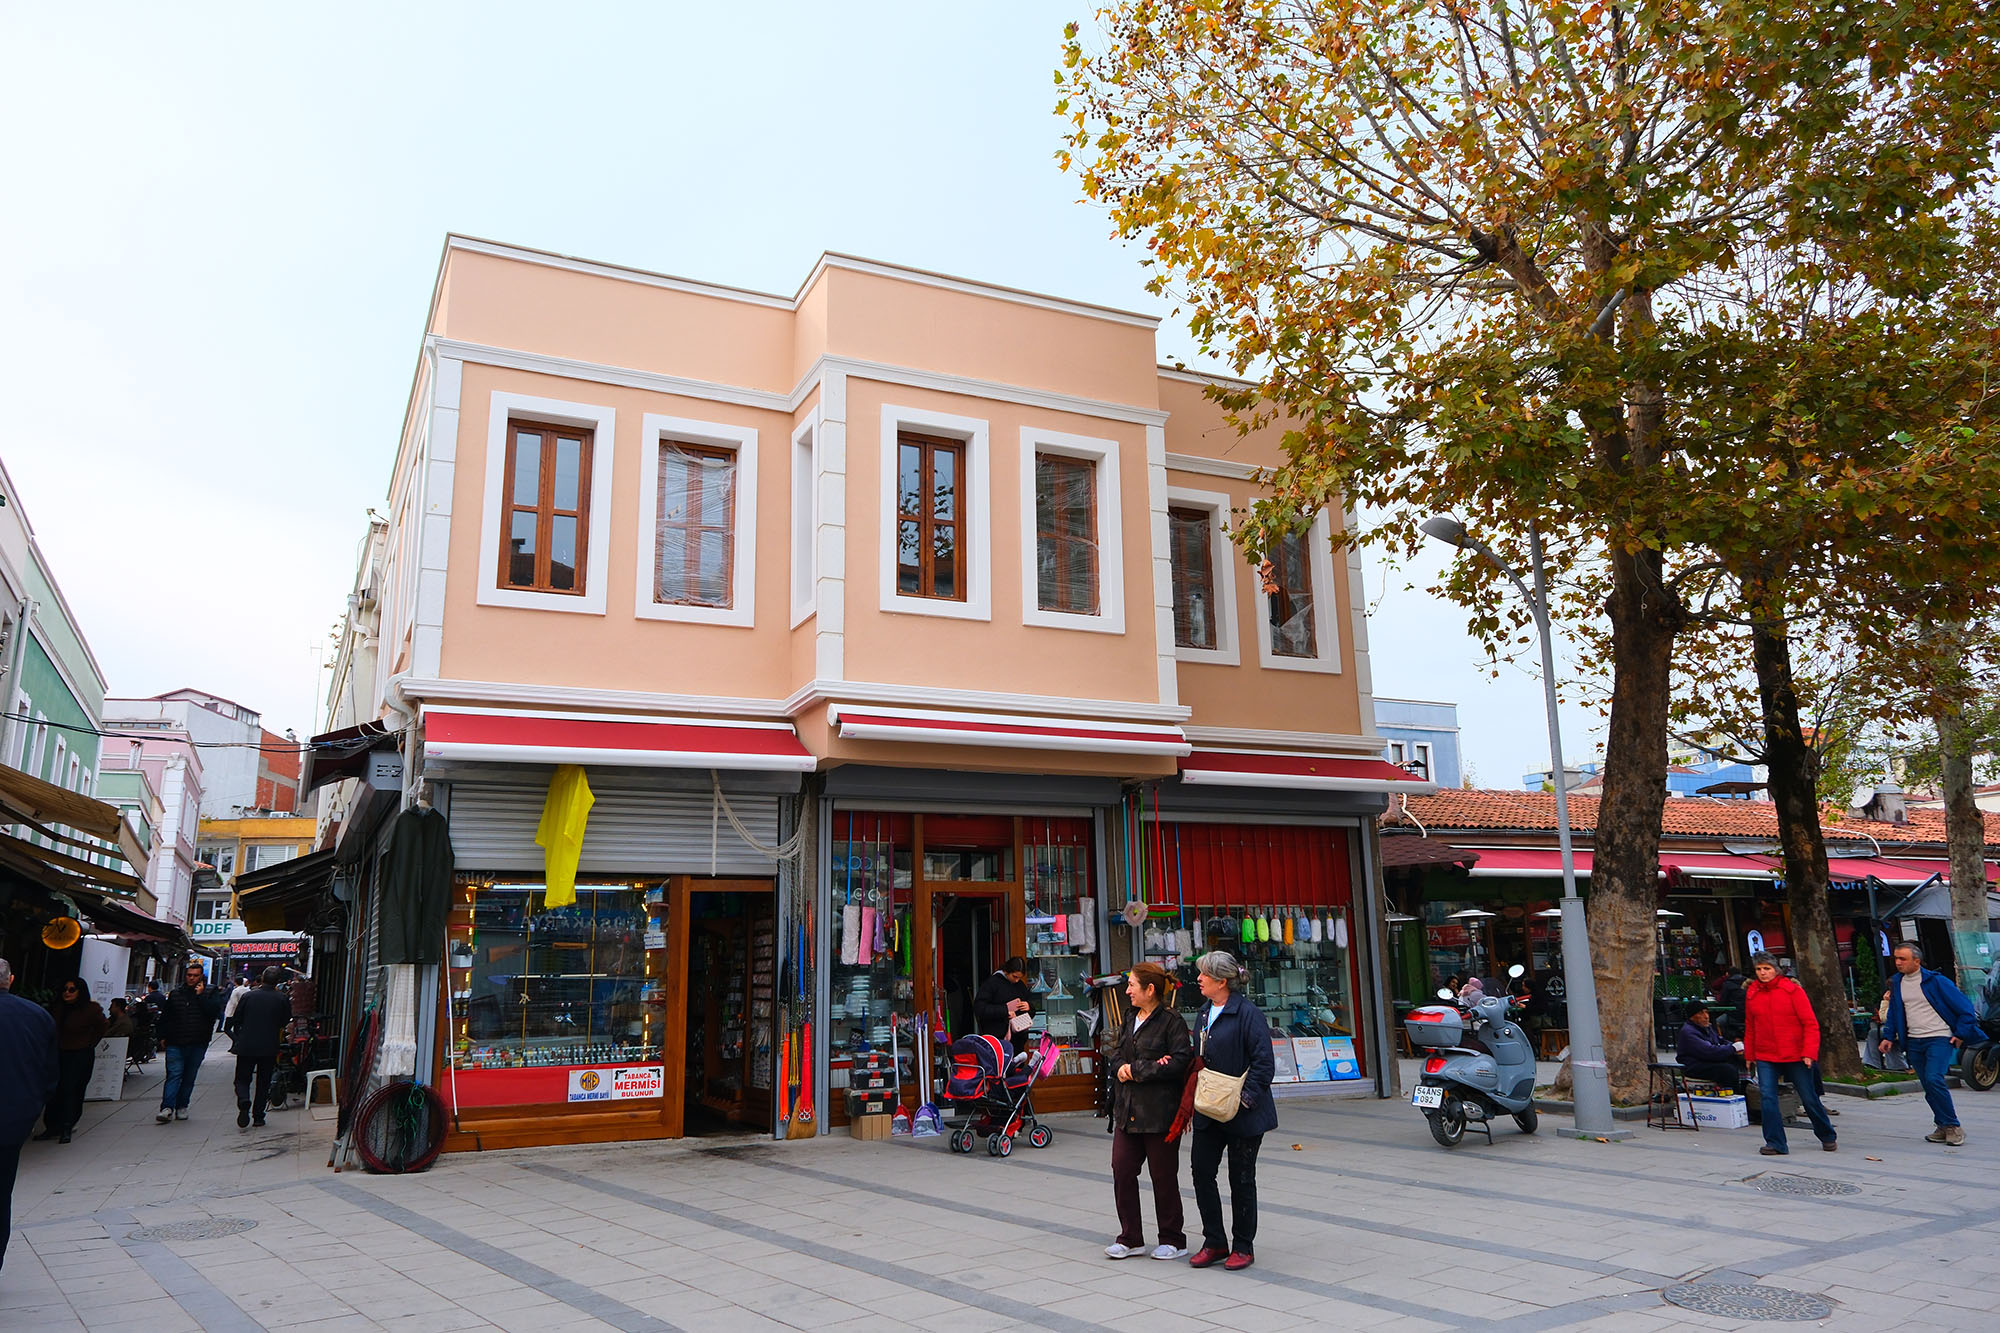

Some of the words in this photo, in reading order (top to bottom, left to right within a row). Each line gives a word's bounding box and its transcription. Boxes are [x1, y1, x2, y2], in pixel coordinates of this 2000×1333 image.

[231, 942, 278, 953] TAHTAKALE
[615, 1079, 660, 1090] MERMİSİ
[1416, 1087, 1442, 1097] 54ANS
[1419, 1095, 1434, 1104] 092
